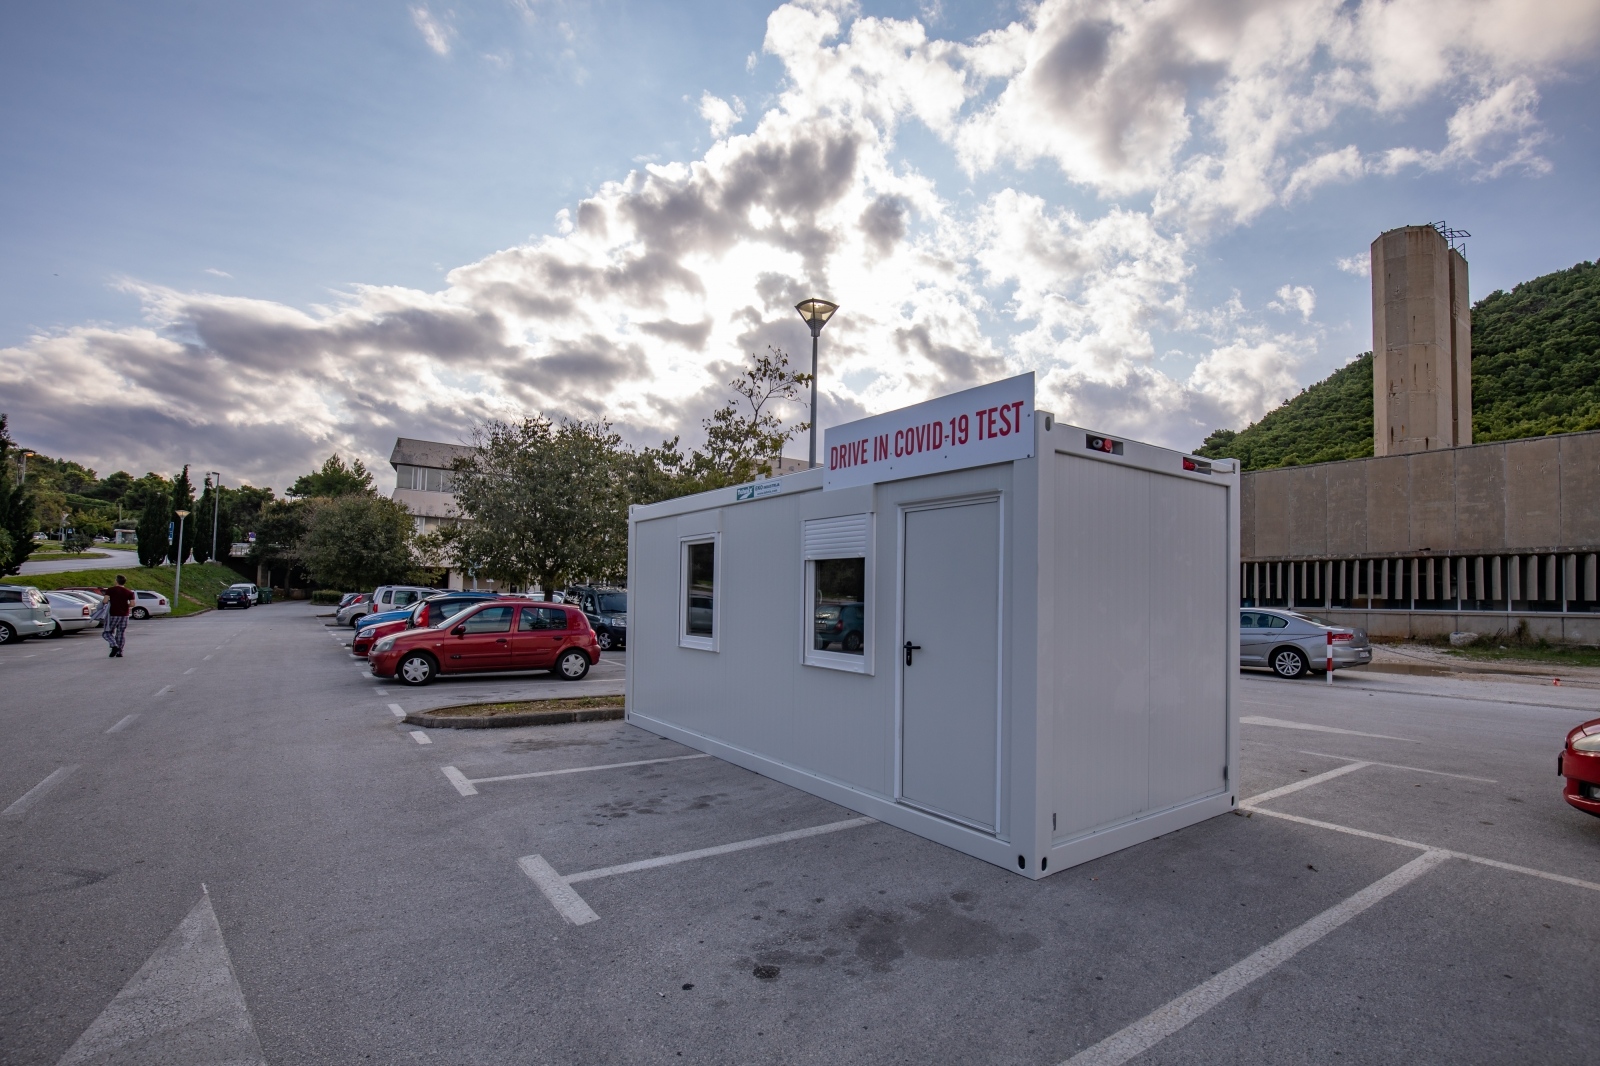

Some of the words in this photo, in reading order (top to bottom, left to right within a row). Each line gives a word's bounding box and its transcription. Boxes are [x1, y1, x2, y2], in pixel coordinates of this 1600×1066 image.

[830, 438, 869, 471] DRIVE
[873, 433, 889, 462] IN
[894, 414, 969, 458] COVID-19
[975, 400, 1024, 441] TEST
